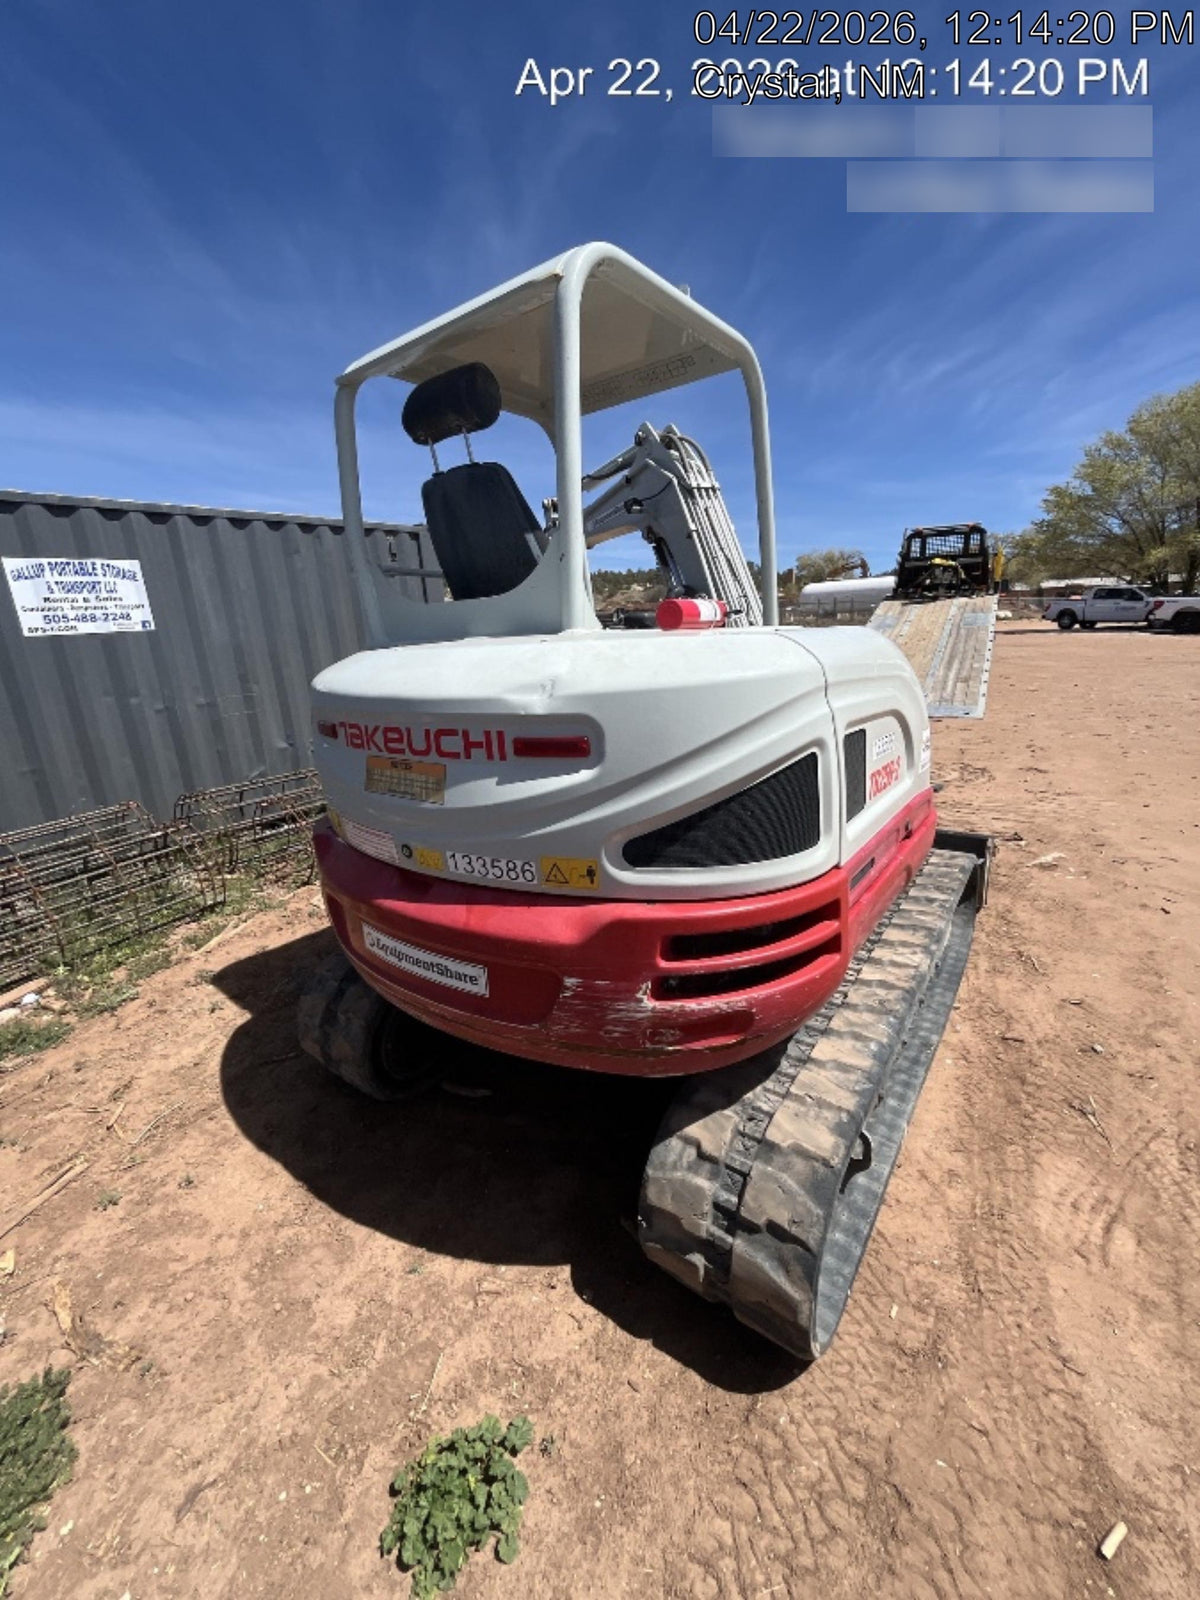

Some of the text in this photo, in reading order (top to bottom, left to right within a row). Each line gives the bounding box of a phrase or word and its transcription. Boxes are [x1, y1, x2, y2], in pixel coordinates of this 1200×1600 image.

[47, 561, 99, 577] PORTABLE
[100, 562, 139, 582] STORAGE
[55, 580, 102, 595] TRANSPORT
[449, 852, 536, 883] 133586
